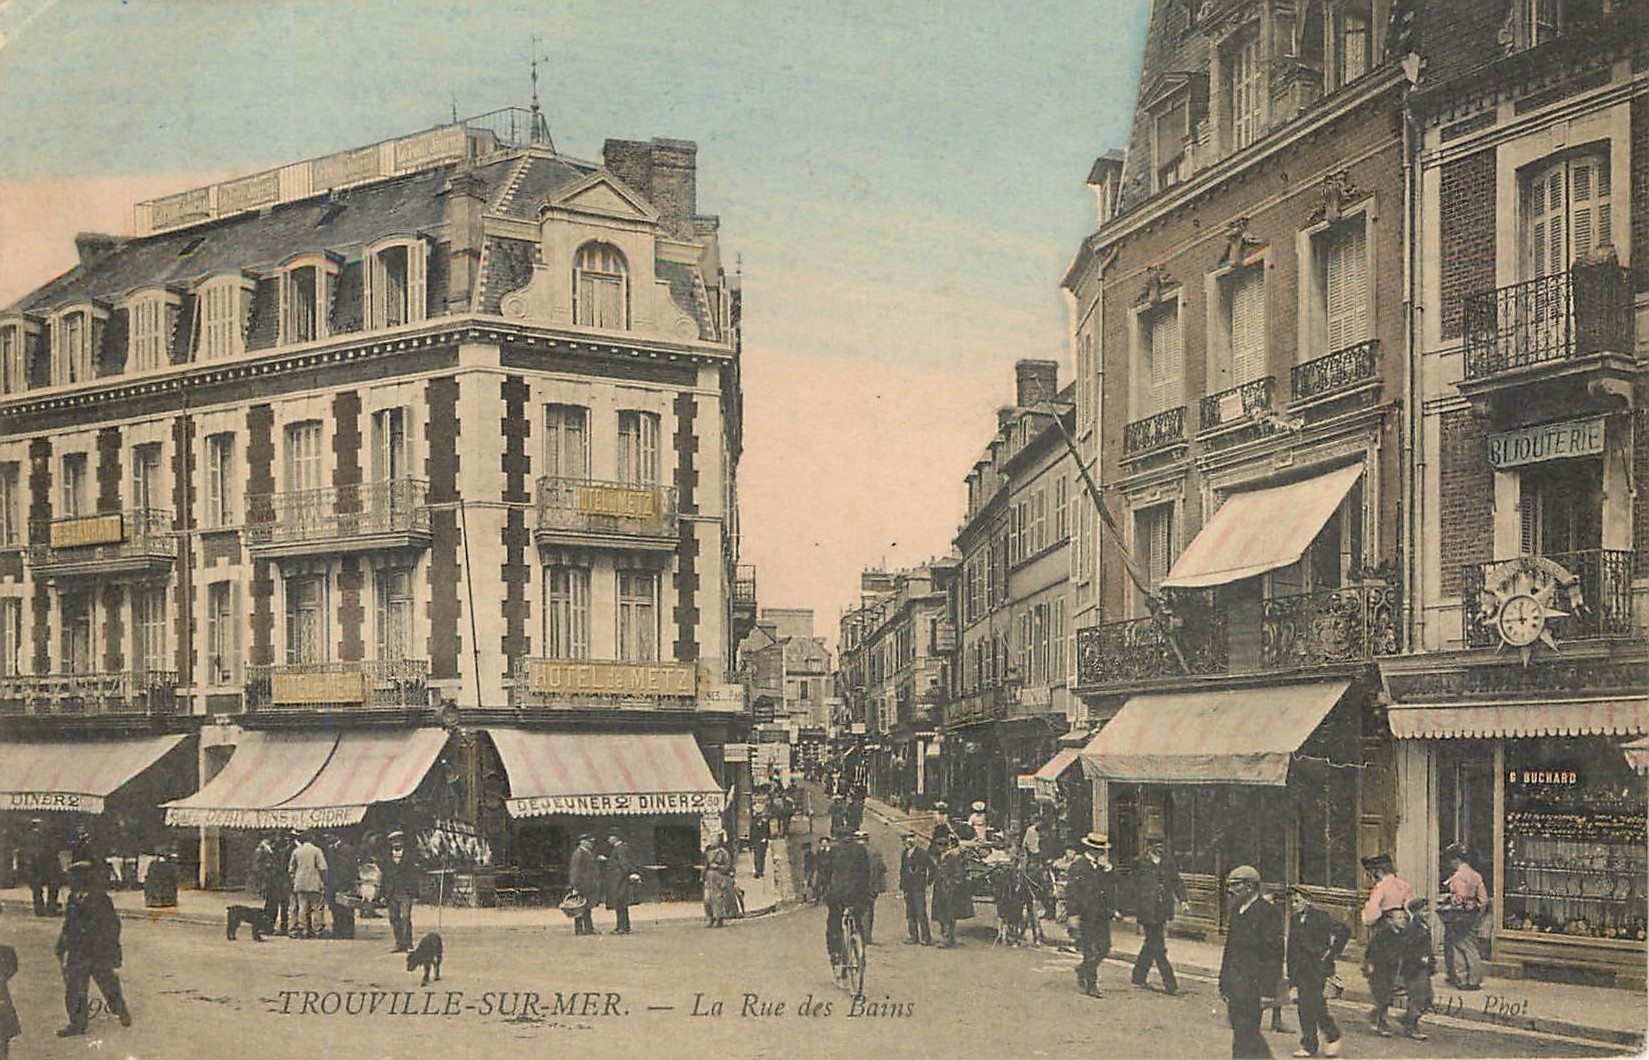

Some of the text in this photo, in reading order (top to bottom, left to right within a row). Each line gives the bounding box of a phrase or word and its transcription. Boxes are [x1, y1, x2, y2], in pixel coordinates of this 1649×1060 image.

[1490, 425, 1600, 465] BIJOUTERIE
[535, 665, 602, 690] HOTEL
[631, 667, 689, 692] METZ
[1523, 771, 1577, 784] BUCHARD
[10, 794, 65, 807] DINER
[516, 796, 611, 812] DEJEUNER
[638, 794, 688, 809] DINER
